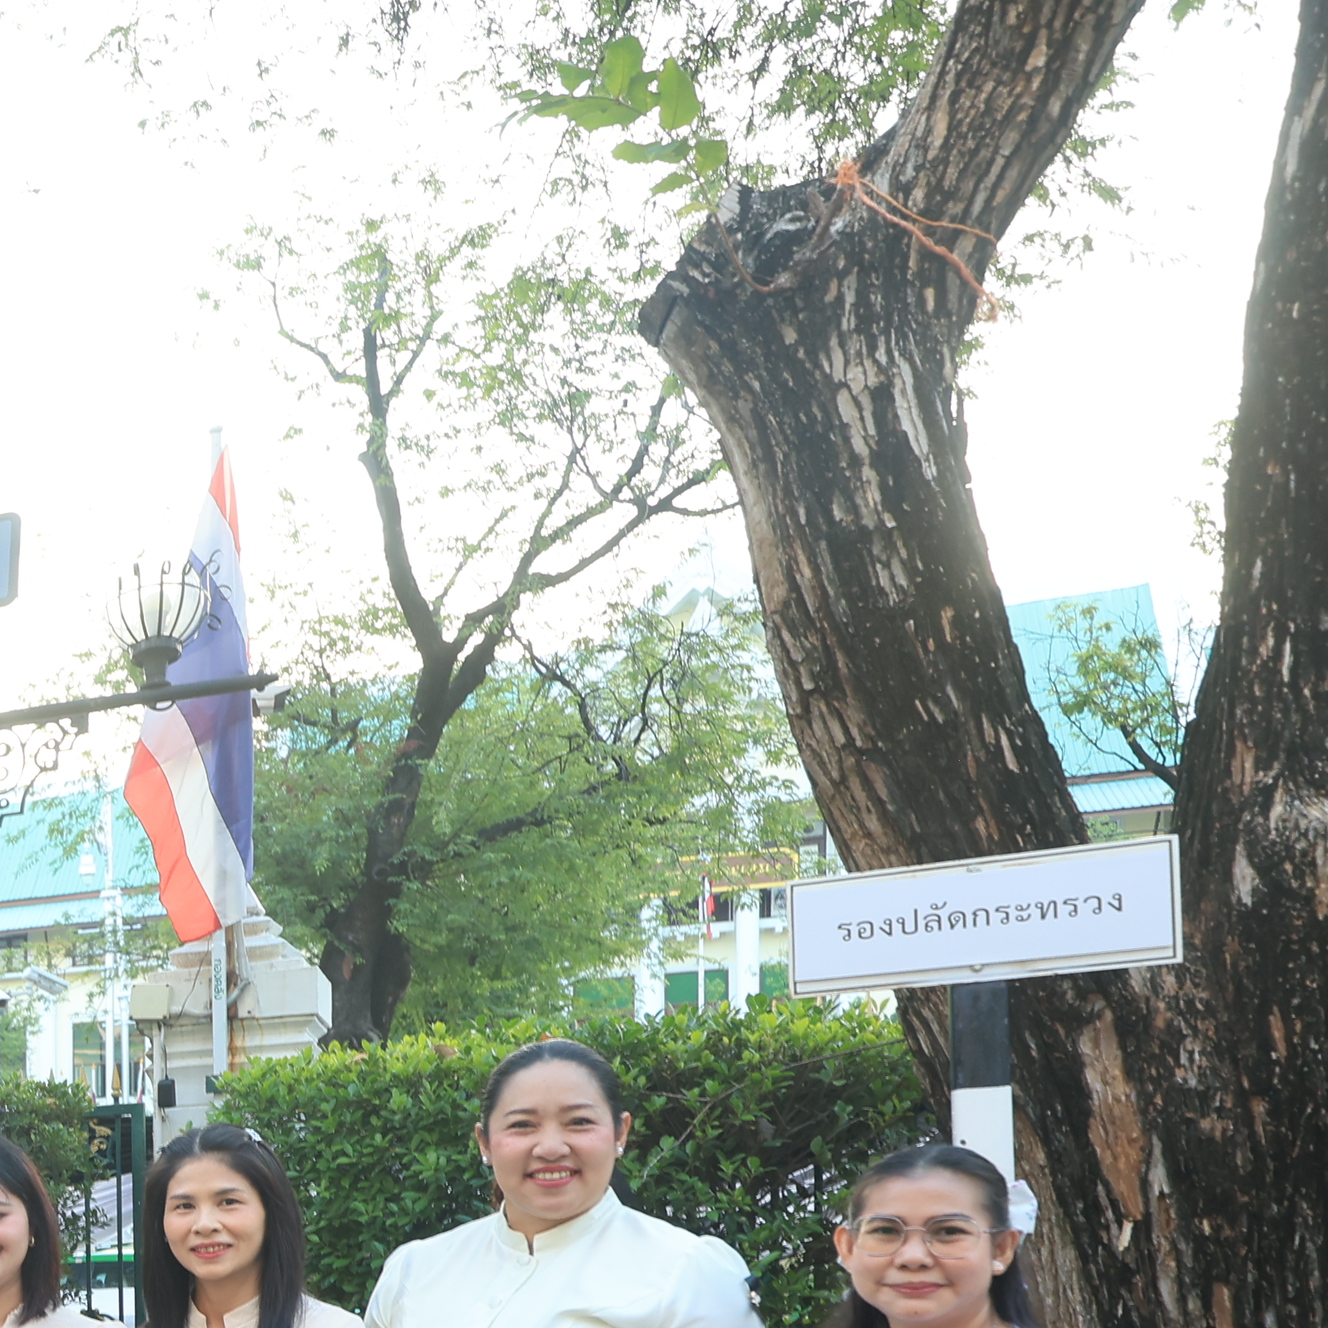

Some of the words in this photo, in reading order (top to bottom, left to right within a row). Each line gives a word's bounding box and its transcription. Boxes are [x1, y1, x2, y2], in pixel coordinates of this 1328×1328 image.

[837, 892, 1123, 942] รองปลัดกระทรวง
